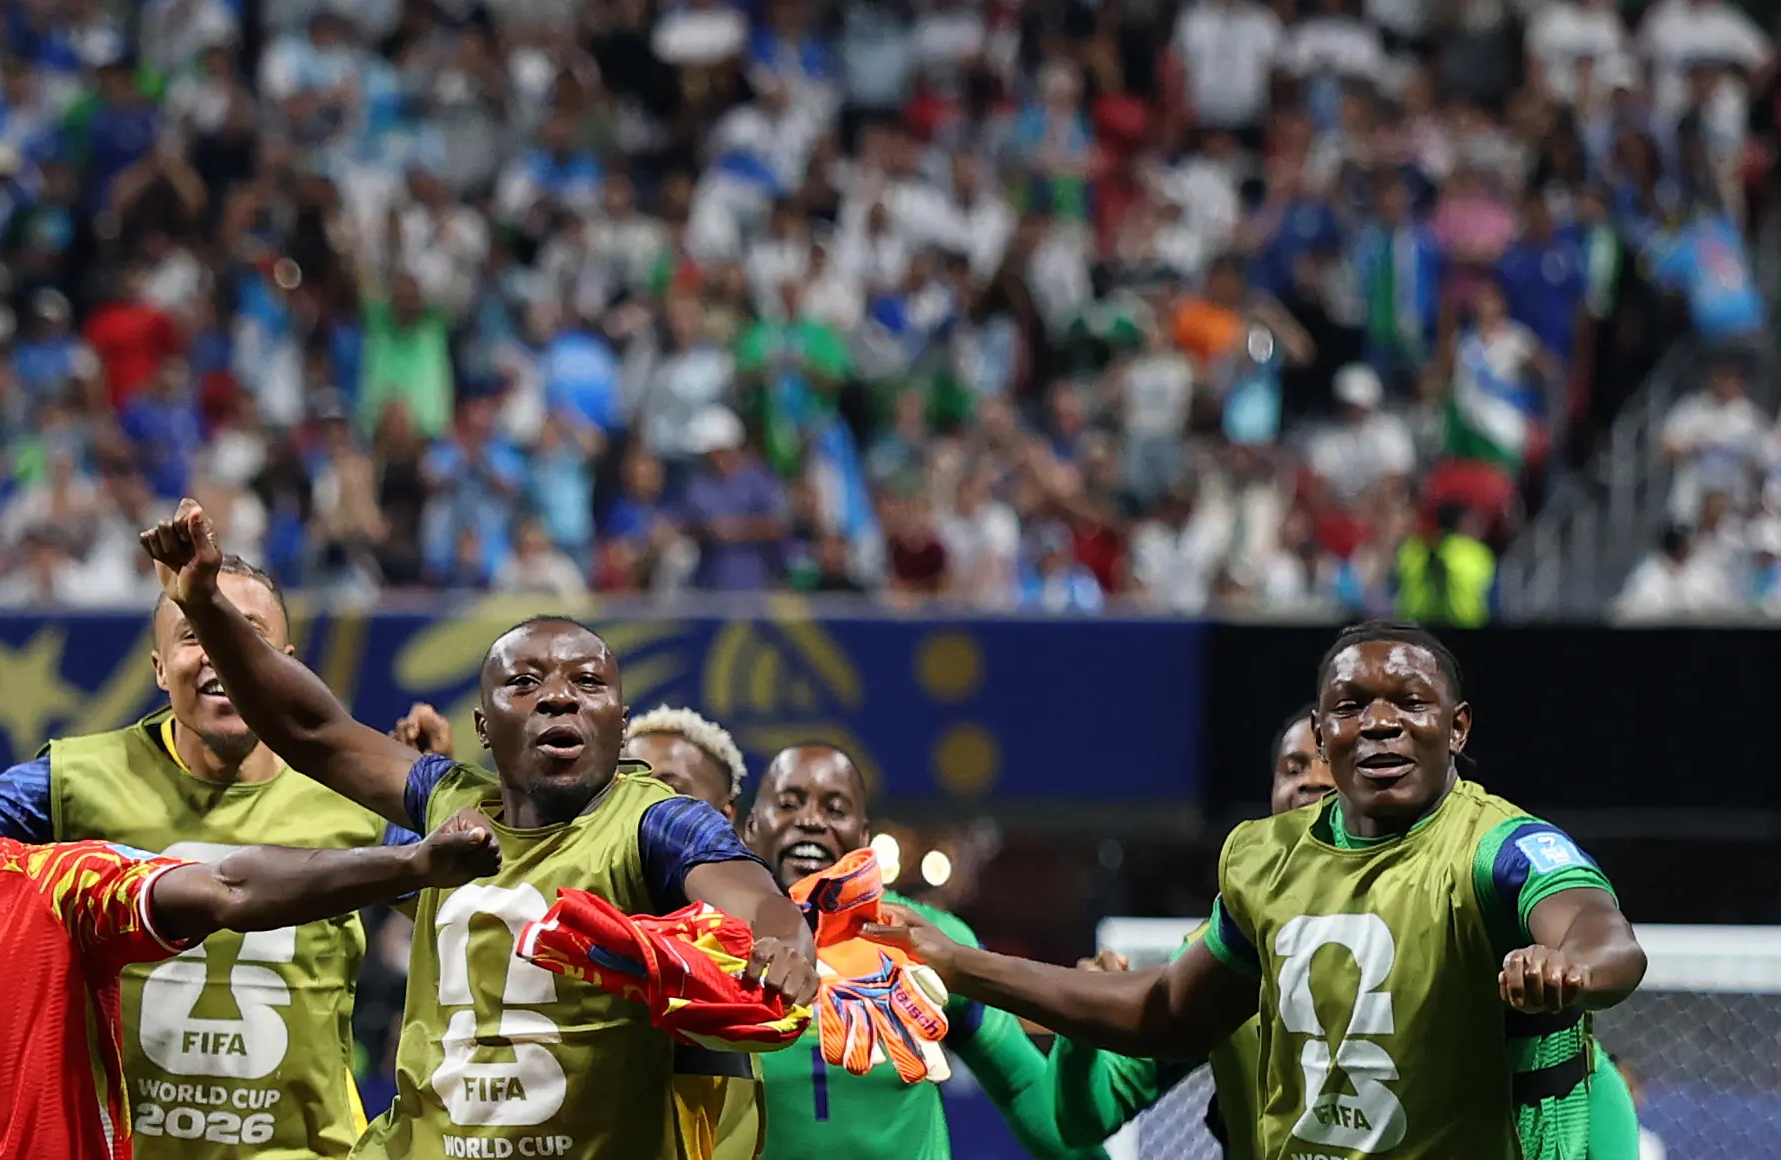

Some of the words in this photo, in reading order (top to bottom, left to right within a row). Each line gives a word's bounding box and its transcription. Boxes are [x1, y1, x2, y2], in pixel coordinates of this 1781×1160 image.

[181, 1030, 247, 1056] FIFA
[137, 1078, 228, 1106] WORLD
[232, 1088, 281, 1110] CUP
[463, 1076, 528, 1102] FIFA
[135, 1102, 275, 1145] 2026
[1313, 1103, 1372, 1131] FIFA
[443, 1134, 513, 1159] WORLD
[518, 1135, 573, 1157] CUP
